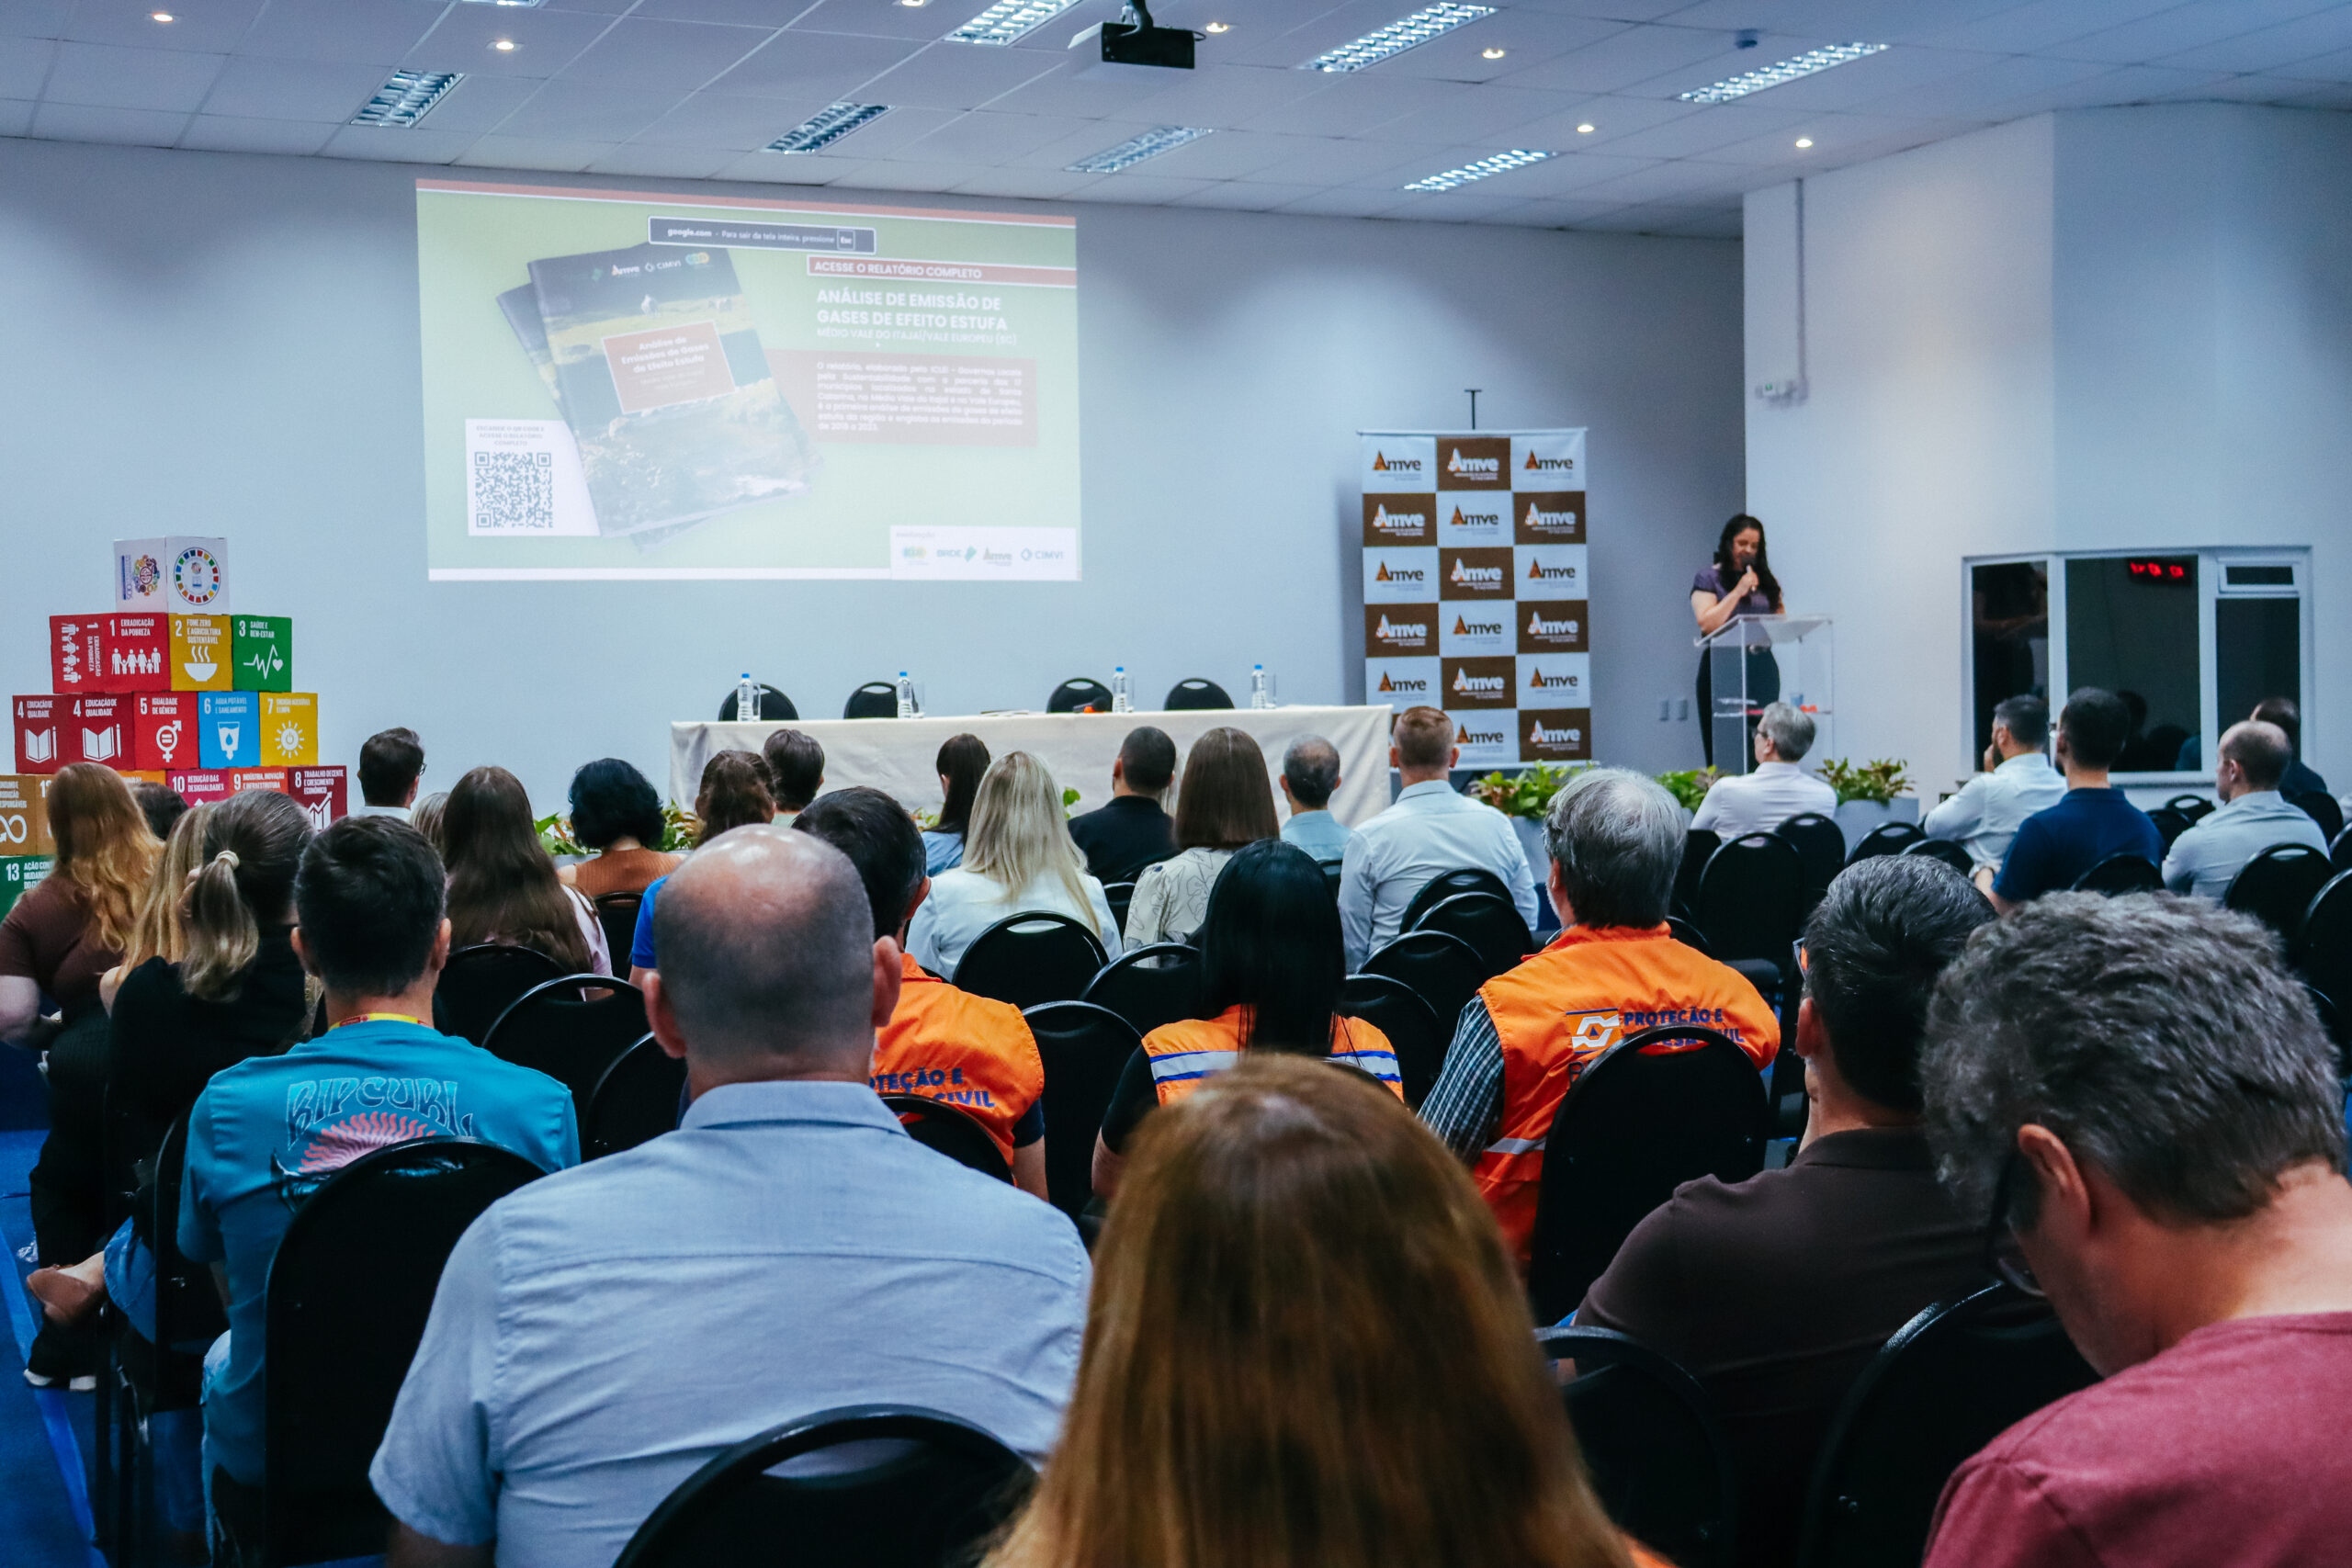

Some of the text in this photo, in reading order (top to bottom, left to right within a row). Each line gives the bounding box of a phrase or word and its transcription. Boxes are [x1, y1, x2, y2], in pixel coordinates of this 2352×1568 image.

[668, 229, 712, 238] google.com
[722, 231, 737, 239] Para
[814, 262, 981, 278] ACESSE O RELATÓRIO COMPLETO
[817, 287, 1001, 310] ANÁLISE DE EMISSÃO DE
[817, 310, 1008, 331] GASES DE EFEITO ESTUFA
[851, 330, 871, 339] VALE
[680, 343, 709, 354] Gases
[1373, 449, 1421, 471] Amve
[1446, 447, 1499, 472] Amve
[1524, 448, 1573, 470] Amve
[1372, 503, 1426, 527] Amve
[1450, 504, 1498, 525] Amve
[1524, 502, 1577, 526] Amve
[1375, 559, 1424, 581] Amve
[1450, 558, 1502, 581] Amve
[1528, 557, 1575, 579] Amve
[109, 618, 116, 637] 1
[175, 620, 182, 637] 2
[239, 620, 246, 637] 3
[1375, 614, 1428, 638] Amve
[1453, 614, 1502, 635] Amve
[1527, 611, 1578, 635] Amve
[1378, 670, 1427, 692] Amve
[1453, 667, 1505, 692] Amve
[1530, 666, 1577, 687] Amve
[17, 701, 24, 718] 4
[74, 699, 81, 717] 4
[85, 699, 110, 707] EDUCAÇÃO
[85, 708, 113, 716] QUALIDADE
[141, 697, 147, 715] 5
[204, 697, 211, 715] 6
[267, 698, 274, 715] 7
[1455, 723, 1504, 743] Amve
[1529, 719, 1580, 743] Amve
[173, 775, 185, 793] 10
[209, 774, 219, 783] DAS
[233, 773, 241, 790] 9
[295, 772, 301, 788] 8
[6, 863, 19, 882] 13
[23, 861, 39, 871] AÇÃO
[1714, 1009, 1723, 1022] E
[952, 1067, 963, 1084] E
